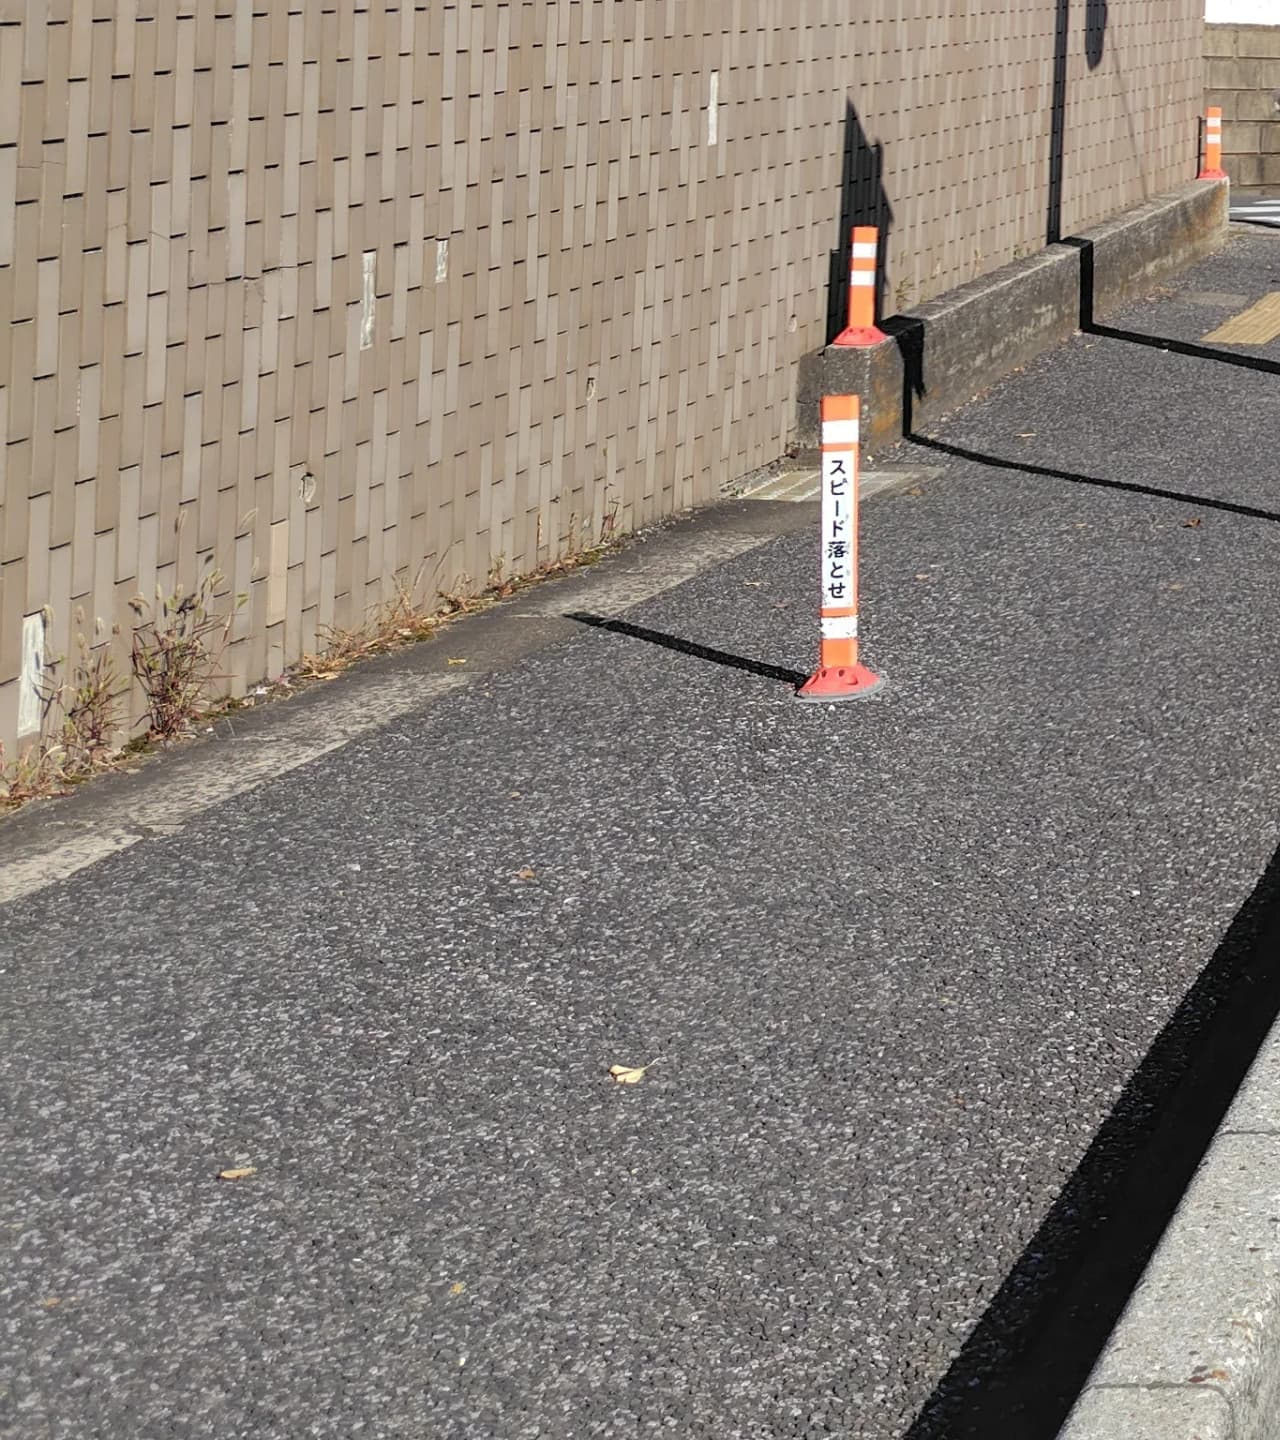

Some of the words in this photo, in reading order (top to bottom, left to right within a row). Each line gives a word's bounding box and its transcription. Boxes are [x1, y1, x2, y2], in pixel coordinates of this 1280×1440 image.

[828, 459, 848, 600] スピード落とせ
